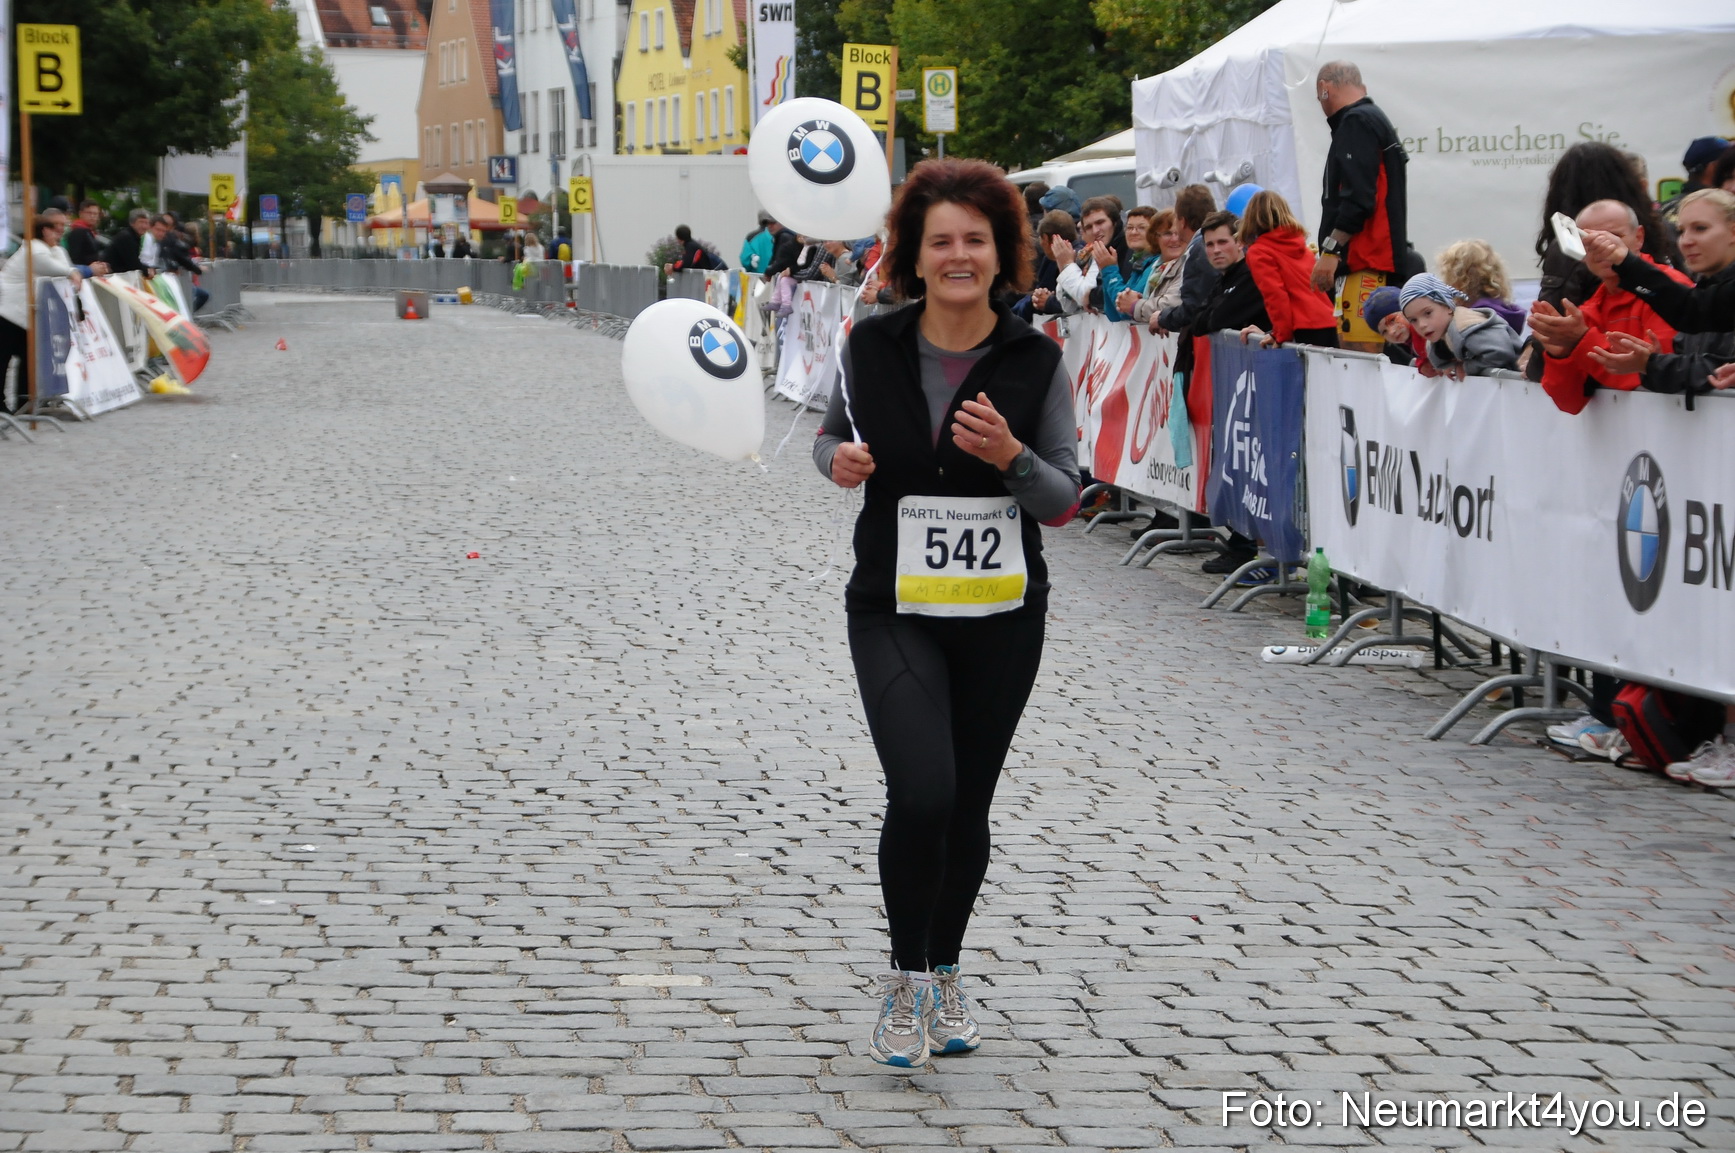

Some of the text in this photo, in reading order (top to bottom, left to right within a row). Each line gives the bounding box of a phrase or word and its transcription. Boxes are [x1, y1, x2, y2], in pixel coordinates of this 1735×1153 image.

[760, 3, 793, 22] swn
[24, 27, 70, 45] Block
[849, 47, 892, 65] Block
[35, 51, 64, 93] B
[855, 70, 882, 111] B
[788, 120, 830, 161] BMW
[1436, 124, 1566, 153] brauchen
[214, 183, 229, 202] C
[574, 186, 588, 205] C
[349, 212, 364, 220] TAXI
[503, 204, 513, 217] D
[690, 320, 731, 347] BMW
[1622, 457, 1666, 510] BMW
[901, 507, 943, 520] PARTL
[946, 509, 1002, 521] Neumarkt
[925, 526, 1001, 570] 542
[915, 583, 999, 598] MARION
